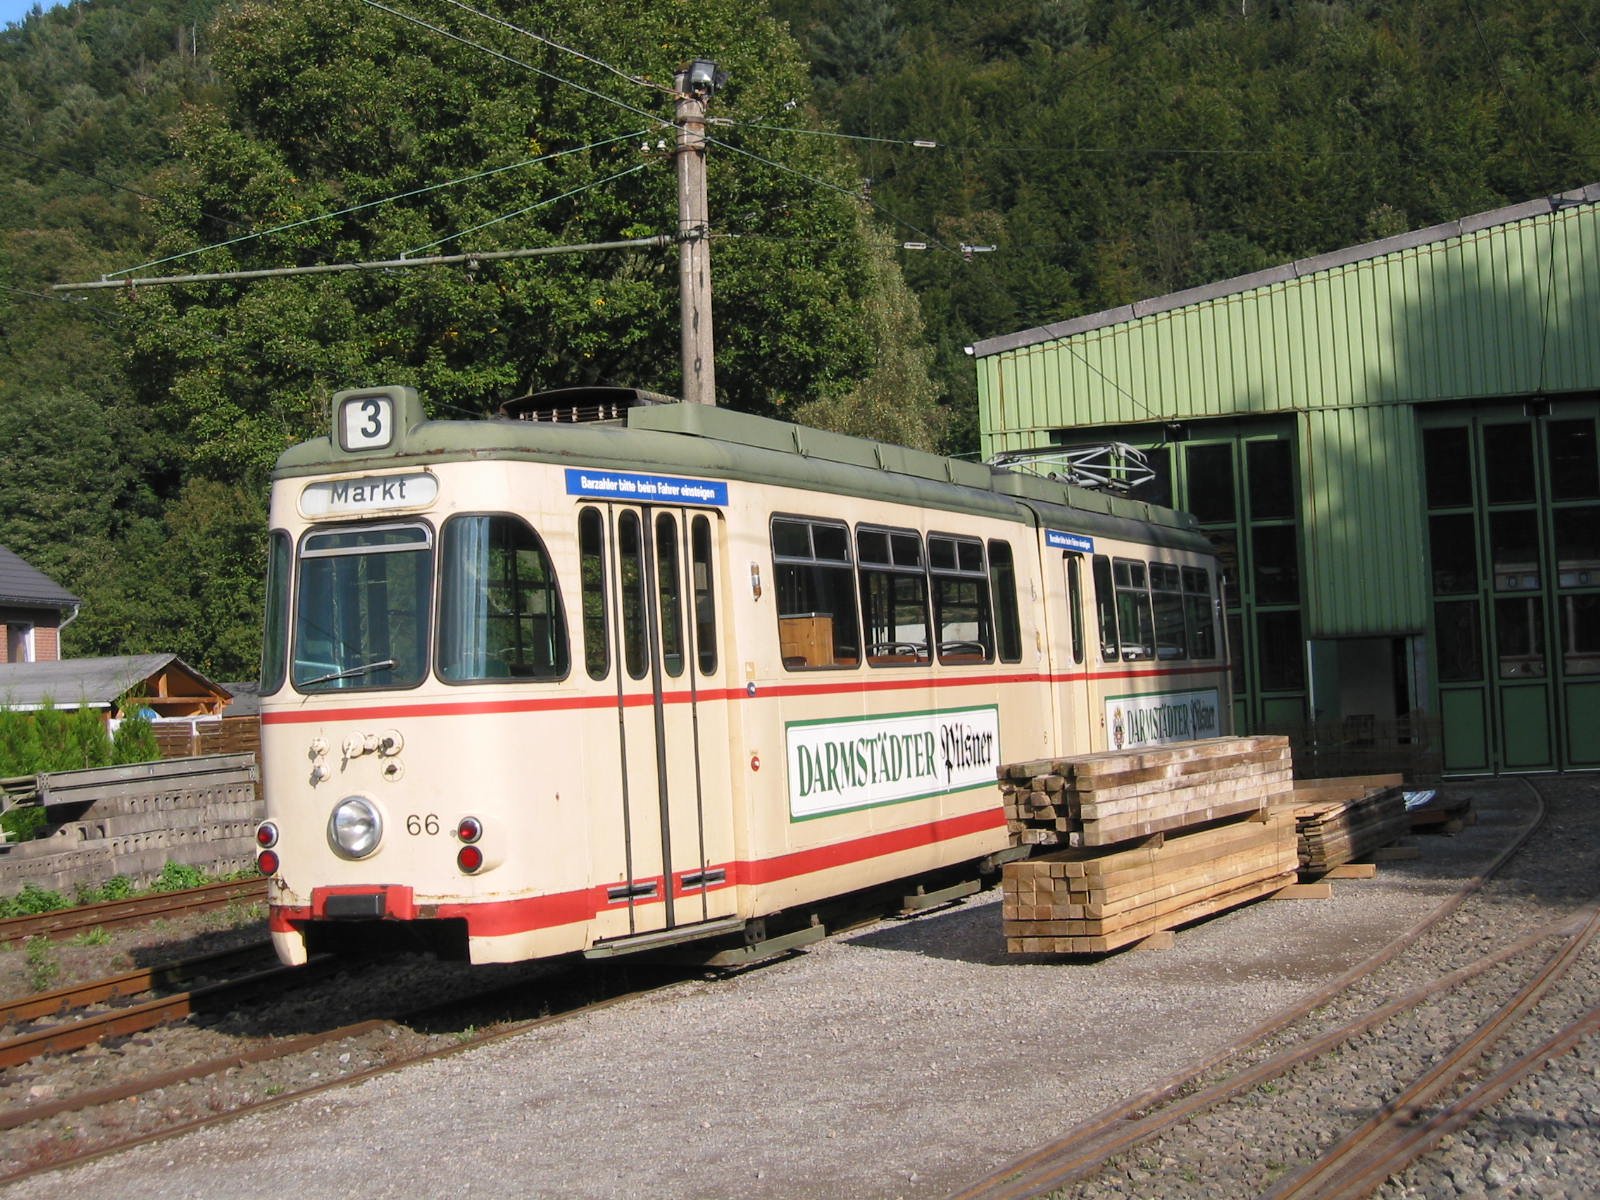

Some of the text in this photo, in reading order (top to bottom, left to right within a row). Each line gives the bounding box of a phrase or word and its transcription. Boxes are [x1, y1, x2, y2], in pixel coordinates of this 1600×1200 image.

[361, 400, 382, 438] 3
[331, 479, 406, 504] Markt
[580, 476, 715, 500] Barzahler bitte beim Fahrer einsteigen
[797, 722, 993, 797] DARMSTÄDTER Pilsner
[406, 813, 440, 836] 66
